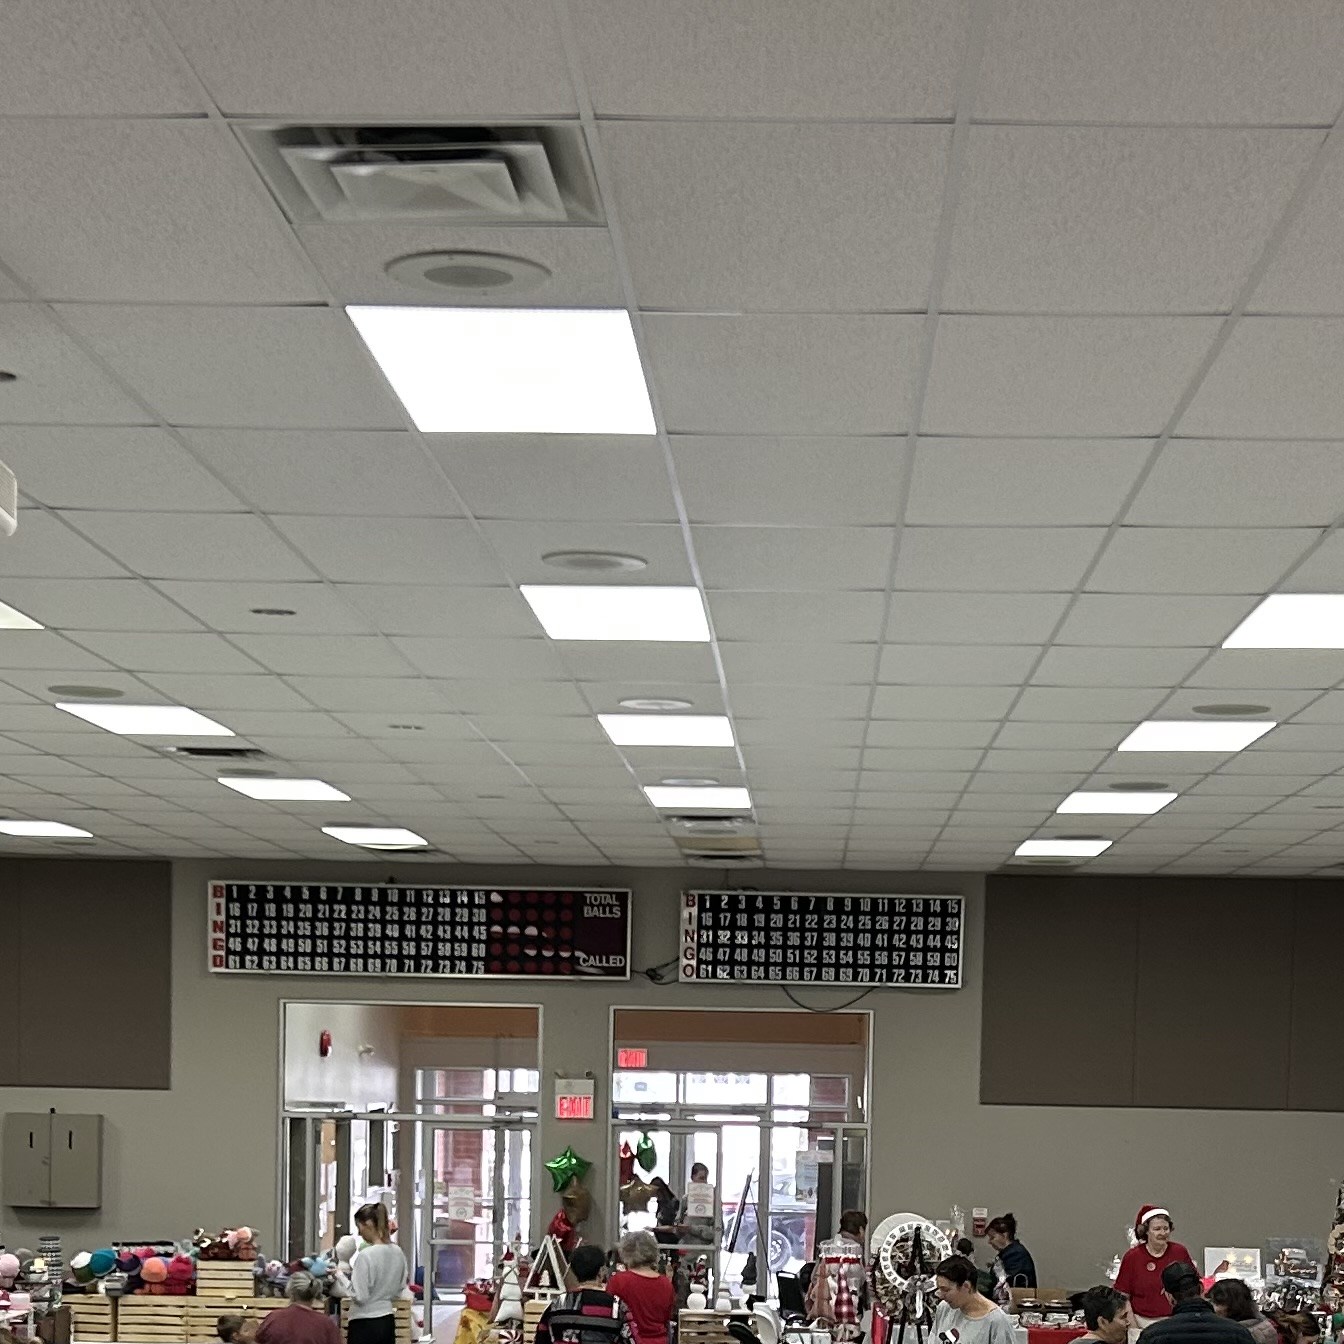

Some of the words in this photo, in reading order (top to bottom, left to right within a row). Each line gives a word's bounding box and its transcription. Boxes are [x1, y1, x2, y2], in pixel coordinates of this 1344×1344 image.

[232, 885, 237, 898] 1
[249, 885, 256, 899] 2
[267, 885, 274, 899] 3
[284, 886, 292, 900] 4
[302, 886, 309, 900] 5
[319, 887, 327, 901] 6
[337, 887, 344, 901] 7
[406, 890, 415, 903] 11
[423, 890, 434, 904] 12
[439, 891, 450, 904] 13
[457, 891, 468, 904] 14
[474, 892, 485, 904] 15
[584, 893, 620, 905] TOTAL
[229, 903, 240, 917] 16
[248, 903, 258, 917] 17
[282, 904, 294, 918] 19
[299, 904, 312, 918] 20
[318, 904, 329, 918] 21
[333, 904, 347, 919] 22
[351, 905, 364, 919] 23
[368, 906, 381, 920] 24
[385, 906, 399, 920] 25
[403, 907, 416, 921] 26
[421, 907, 434, 921] 27
[472, 908, 486, 922] 30
[584, 906, 621, 918] BALLS
[705, 895, 710, 909] 1
[721, 895, 728, 909] 2
[738, 895, 746, 909] 3
[756, 896, 763, 909] 4
[774, 897, 780, 910] 5
[791, 897, 798, 910] 6
[809, 897, 816, 910] 7
[844, 898, 852, 911] 9
[860, 898, 871, 912] 10
[878, 899, 888, 912] 11
[895, 899, 906, 913] 12
[912, 899, 923, 913] 13
[929, 900, 941, 913] 14
[946, 900, 959, 914] 15
[229, 920, 241, 934] 31
[246, 920, 259, 934] 32
[263, 920, 277, 934] 33
[281, 921, 294, 934] 34
[297, 921, 311, 936] 35
[315, 922, 329, 936] 36
[333, 922, 346, 936] 37
[386, 924, 399, 938] 40
[405, 924, 416, 938] 41
[420, 925, 433, 939] 42
[438, 925, 451, 939] 43
[455, 926, 469, 939] 44
[473, 926, 487, 940] 45
[719, 913, 731, 926] 17
[736, 913, 748, 927] 18
[770, 914, 783, 928] 20
[788, 914, 800, 928] 21
[805, 915, 818, 928] 22
[824, 915, 836, 928] 23
[841, 915, 854, 929] 24
[858, 916, 871, 929] 25
[876, 916, 889, 930] 26
[893, 916, 906, 930] 27
[946, 918, 959, 931] 30
[228, 937, 242, 952] 46
[247, 938, 259, 952] 47
[281, 938, 294, 952] 49
[298, 939, 312, 953] 50
[316, 939, 327, 953] 51
[333, 940, 346, 954] 52
[350, 940, 364, 954] 53
[368, 941, 381, 955] 54
[385, 941, 398, 955] 55
[402, 941, 416, 956] 56
[421, 942, 433, 956] 57
[454, 943, 468, 957] 59
[472, 943, 486, 957] 60
[700, 930, 713, 943] 31
[718, 930, 731, 944] 32
[735, 931, 748, 944] 33
[752, 931, 765, 945] 34
[770, 931, 783, 945] 35
[787, 932, 800, 946] 36
[804, 932, 817, 946] 37
[857, 933, 871, 947] 40
[876, 934, 888, 947] 41
[893, 934, 906, 948] 42
[910, 934, 923, 948] 43
[927, 934, 941, 948] 44
[945, 935, 958, 949] 45
[229, 955, 240, 969] 61
[245, 955, 258, 969] 62
[263, 956, 276, 970] 63
[281, 956, 294, 970] 64
[298, 956, 311, 970] 65
[315, 957, 328, 971] 66
[333, 957, 346, 971] 67
[368, 958, 381, 972] 69
[385, 958, 398, 972] 70
[404, 959, 414, 973] 71
[420, 959, 433, 973] 72
[437, 960, 450, 974] 73
[454, 960, 468, 974] 74
[472, 961, 485, 975] 75
[579, 955, 625, 967] CALLED
[699, 947, 713, 961] 46
[717, 948, 730, 961] 47
[752, 949, 765, 962] 49
[770, 949, 782, 963] 50
[787, 949, 799, 963] 51
[804, 950, 817, 964] 52
[823, 950, 836, 964] 53
[840, 950, 853, 964] 54
[858, 950, 870, 964] 55
[875, 951, 888, 965] 56
[893, 952, 905, 965] 57
[927, 952, 940, 966] 59
[945, 953, 957, 966] 60
[700, 964, 712, 978] 61
[717, 966, 730, 979] 62
[734, 966, 747, 979] 63
[752, 966, 765, 980] 64
[769, 966, 782, 980] 65
[786, 967, 799, 980] 66
[804, 967, 817, 981] 67
[857, 968, 870, 982] 70
[875, 969, 886, 982] 71
[893, 969, 905, 982] 72
[910, 970, 922, 983] 73
[927, 970, 939, 983] 74
[944, 970, 958, 984] 75
